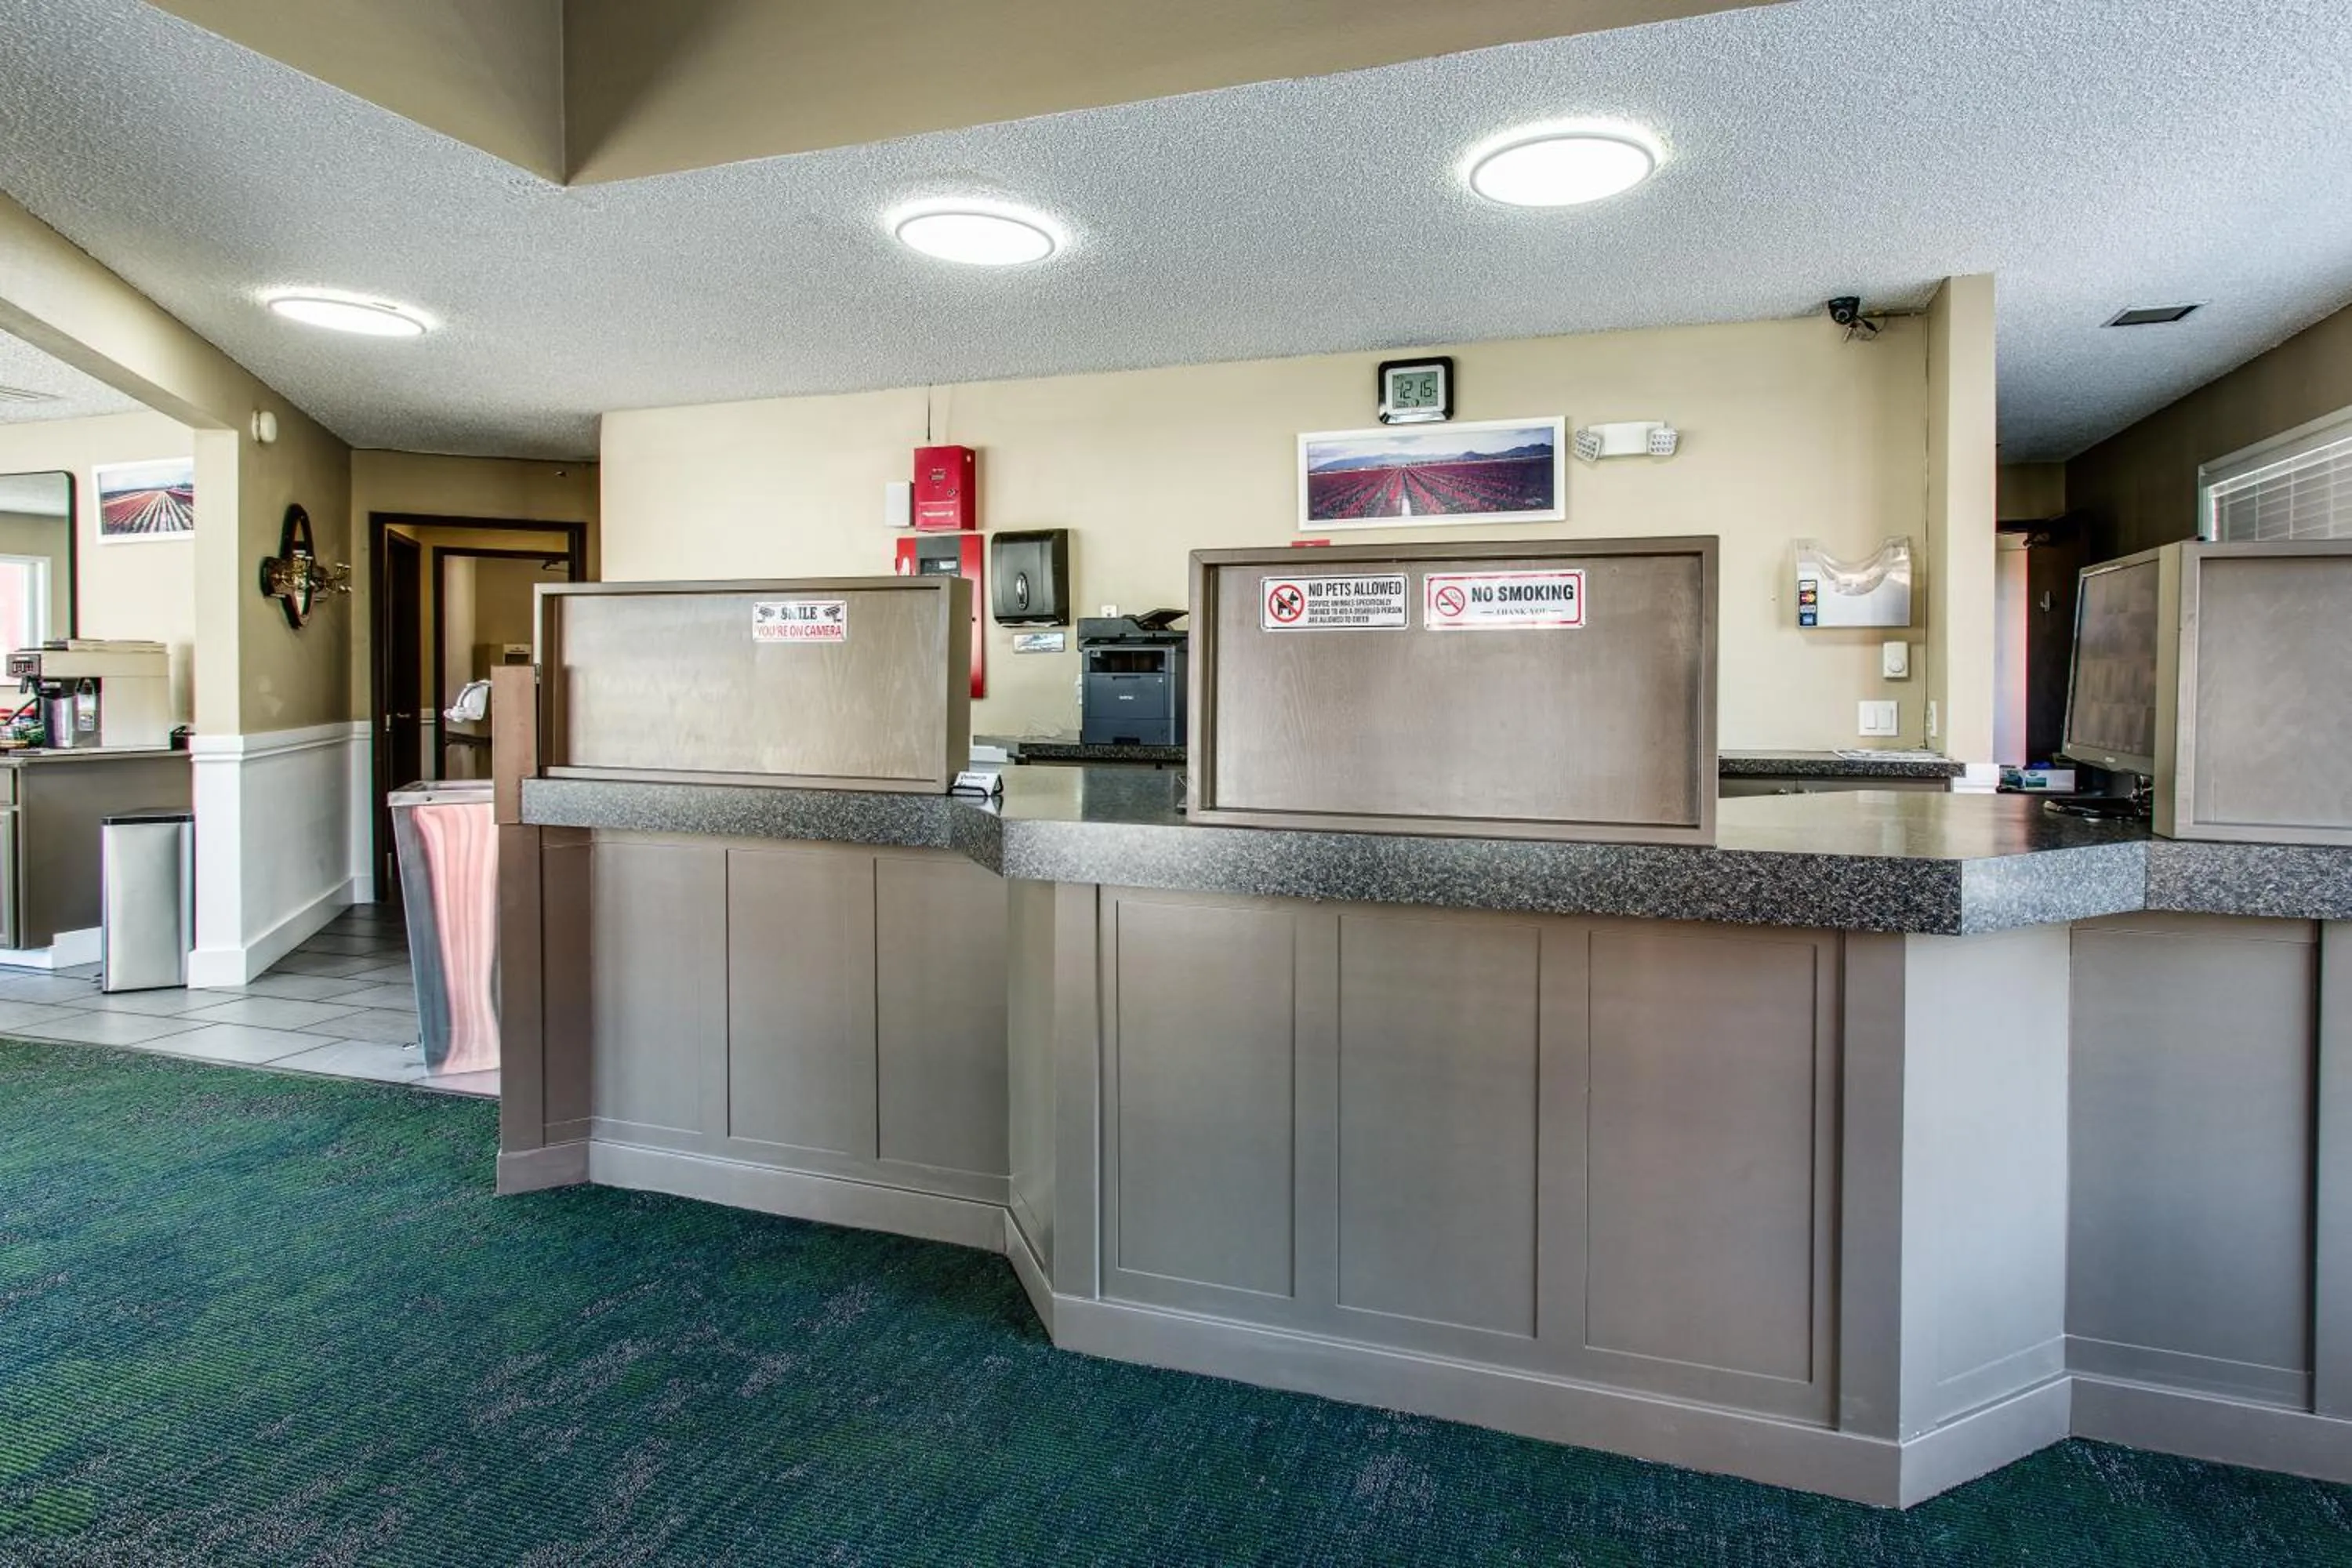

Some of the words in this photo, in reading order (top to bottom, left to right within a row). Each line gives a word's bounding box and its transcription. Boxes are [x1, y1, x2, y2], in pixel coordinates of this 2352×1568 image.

[1308, 583, 1323, 596] NO
[1326, 583, 1351, 596] PETS
[1354, 581, 1401, 595] ALLOWED
[1472, 586, 1494, 602] NO
[1498, 584, 1573, 601] SMOKING
[789, 626, 803, 637] ON
[804, 625, 841, 636] CAMERA
